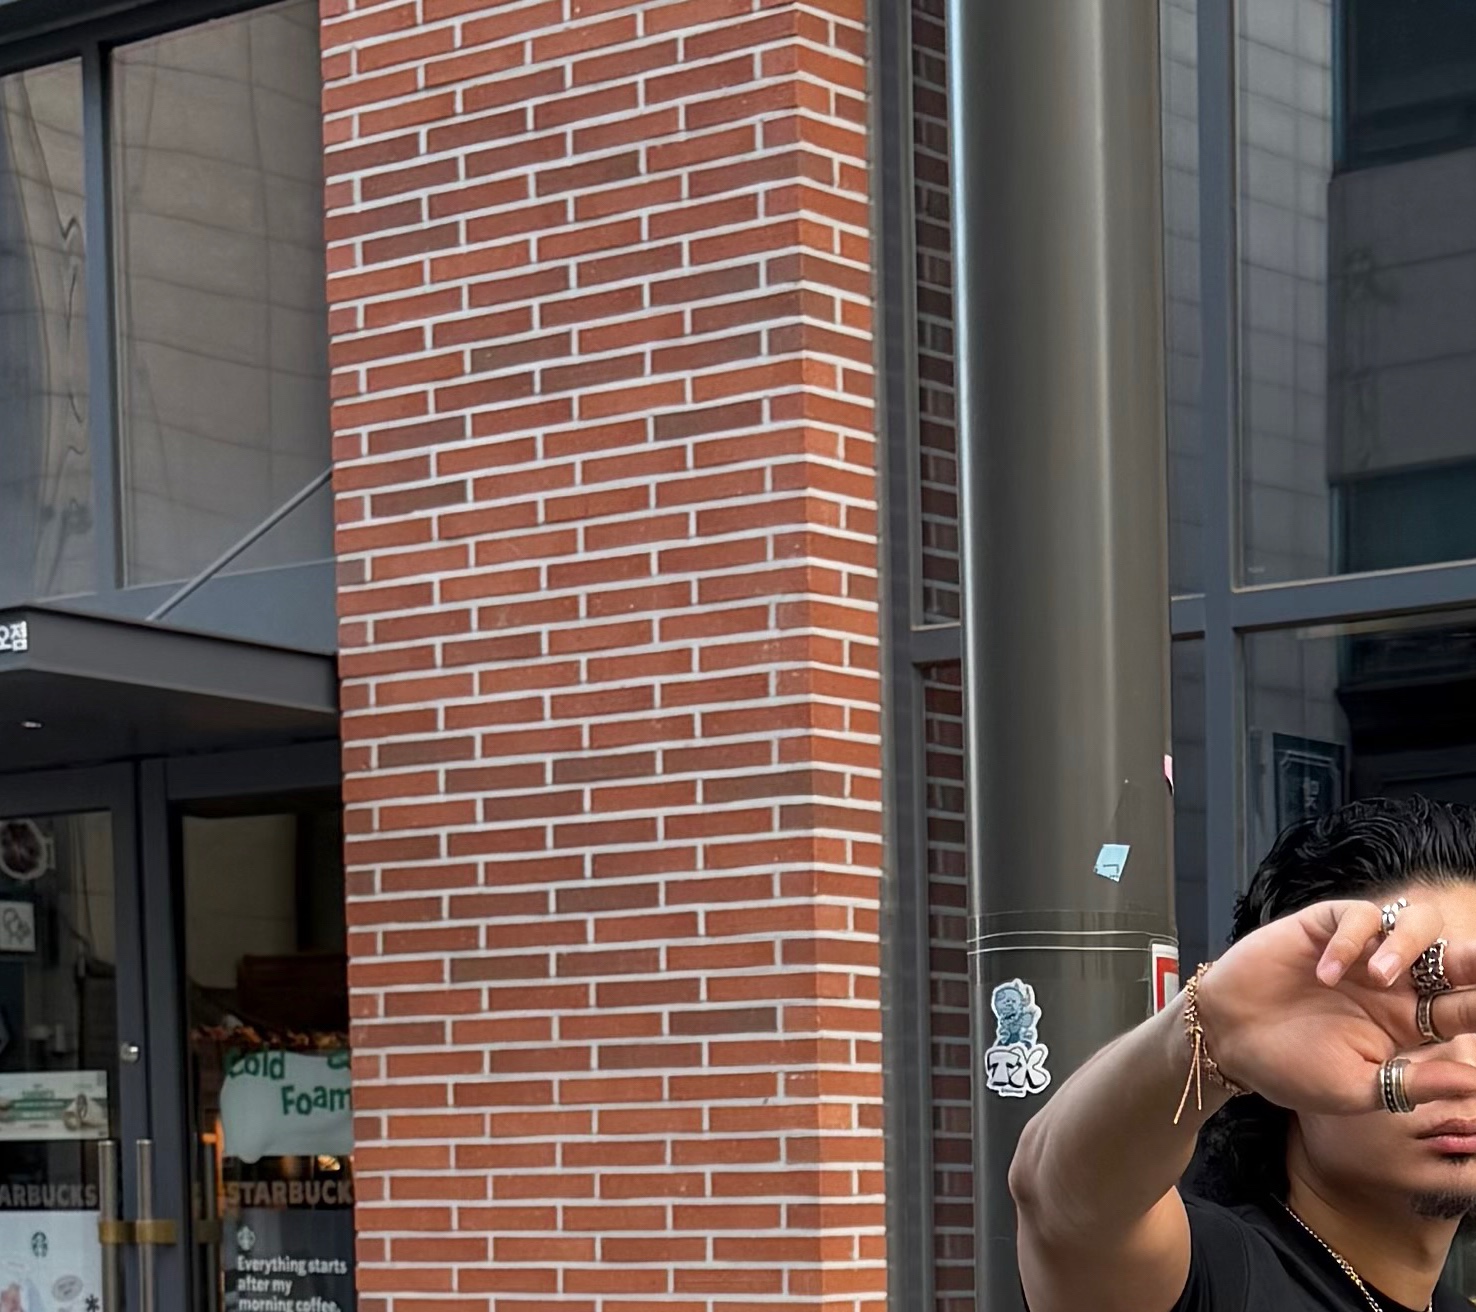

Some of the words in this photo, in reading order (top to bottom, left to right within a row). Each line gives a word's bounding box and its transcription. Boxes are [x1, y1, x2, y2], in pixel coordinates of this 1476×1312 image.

[237, 1255, 307, 1276] Everything
[308, 1259, 347, 1274] starts
[238, 1275, 270, 1292] after
[272, 1280, 293, 1297] my
